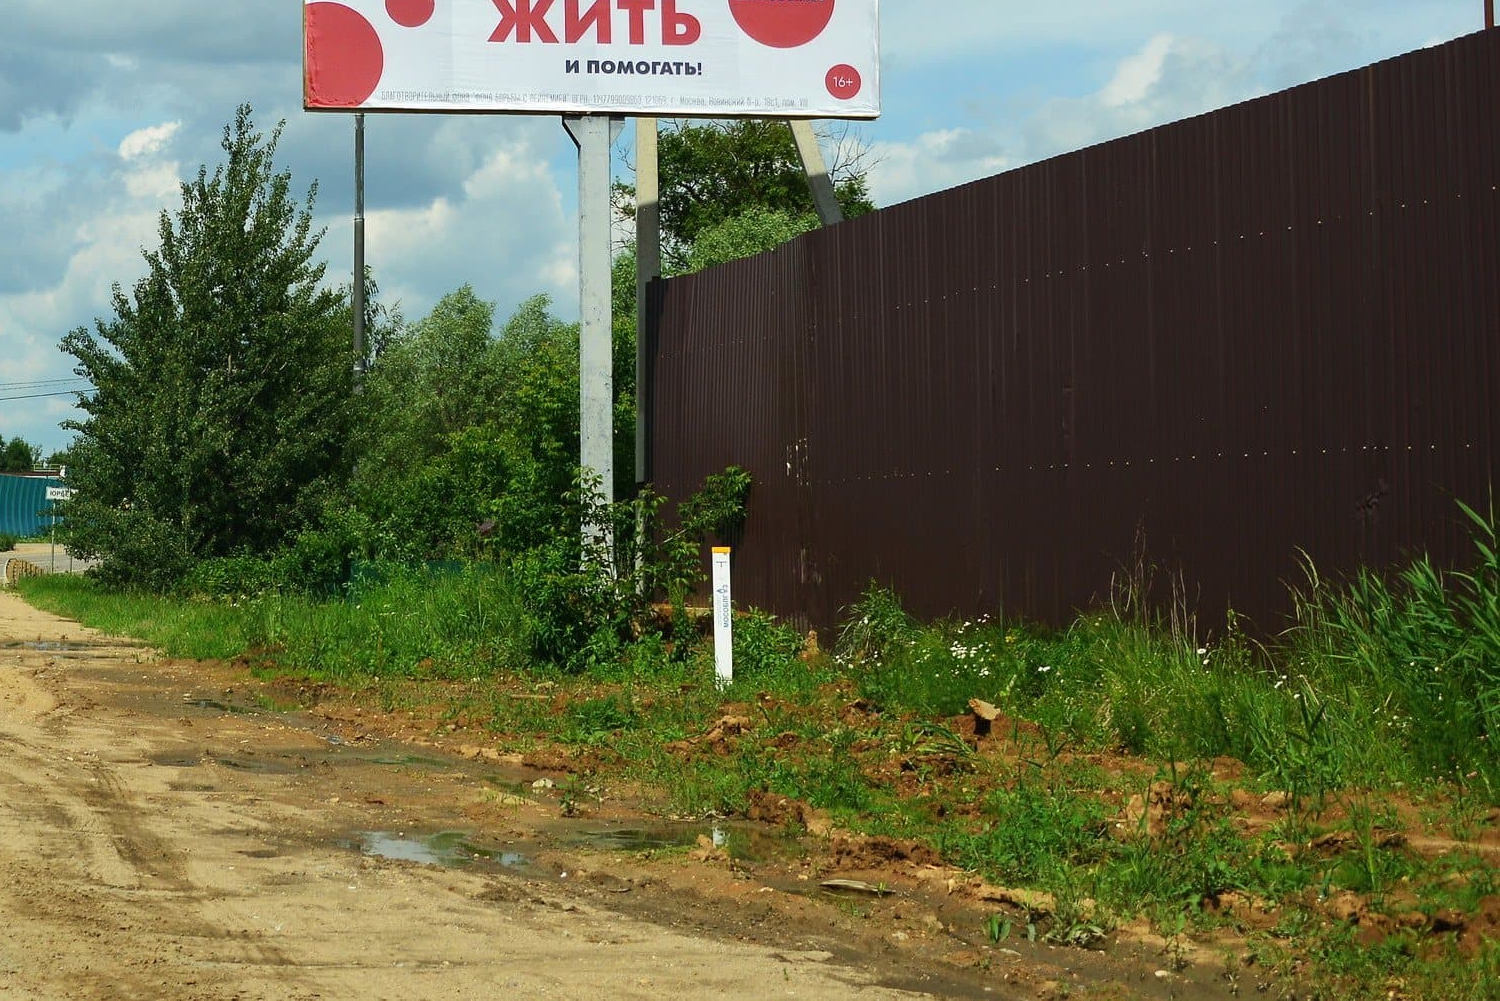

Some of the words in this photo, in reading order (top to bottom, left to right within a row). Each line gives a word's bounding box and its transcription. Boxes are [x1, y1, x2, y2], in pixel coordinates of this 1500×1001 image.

[565, 60, 580, 74] И
[587, 60, 702, 76] ПОМОГАТЬ!
[832, 76, 853, 88] 16+
